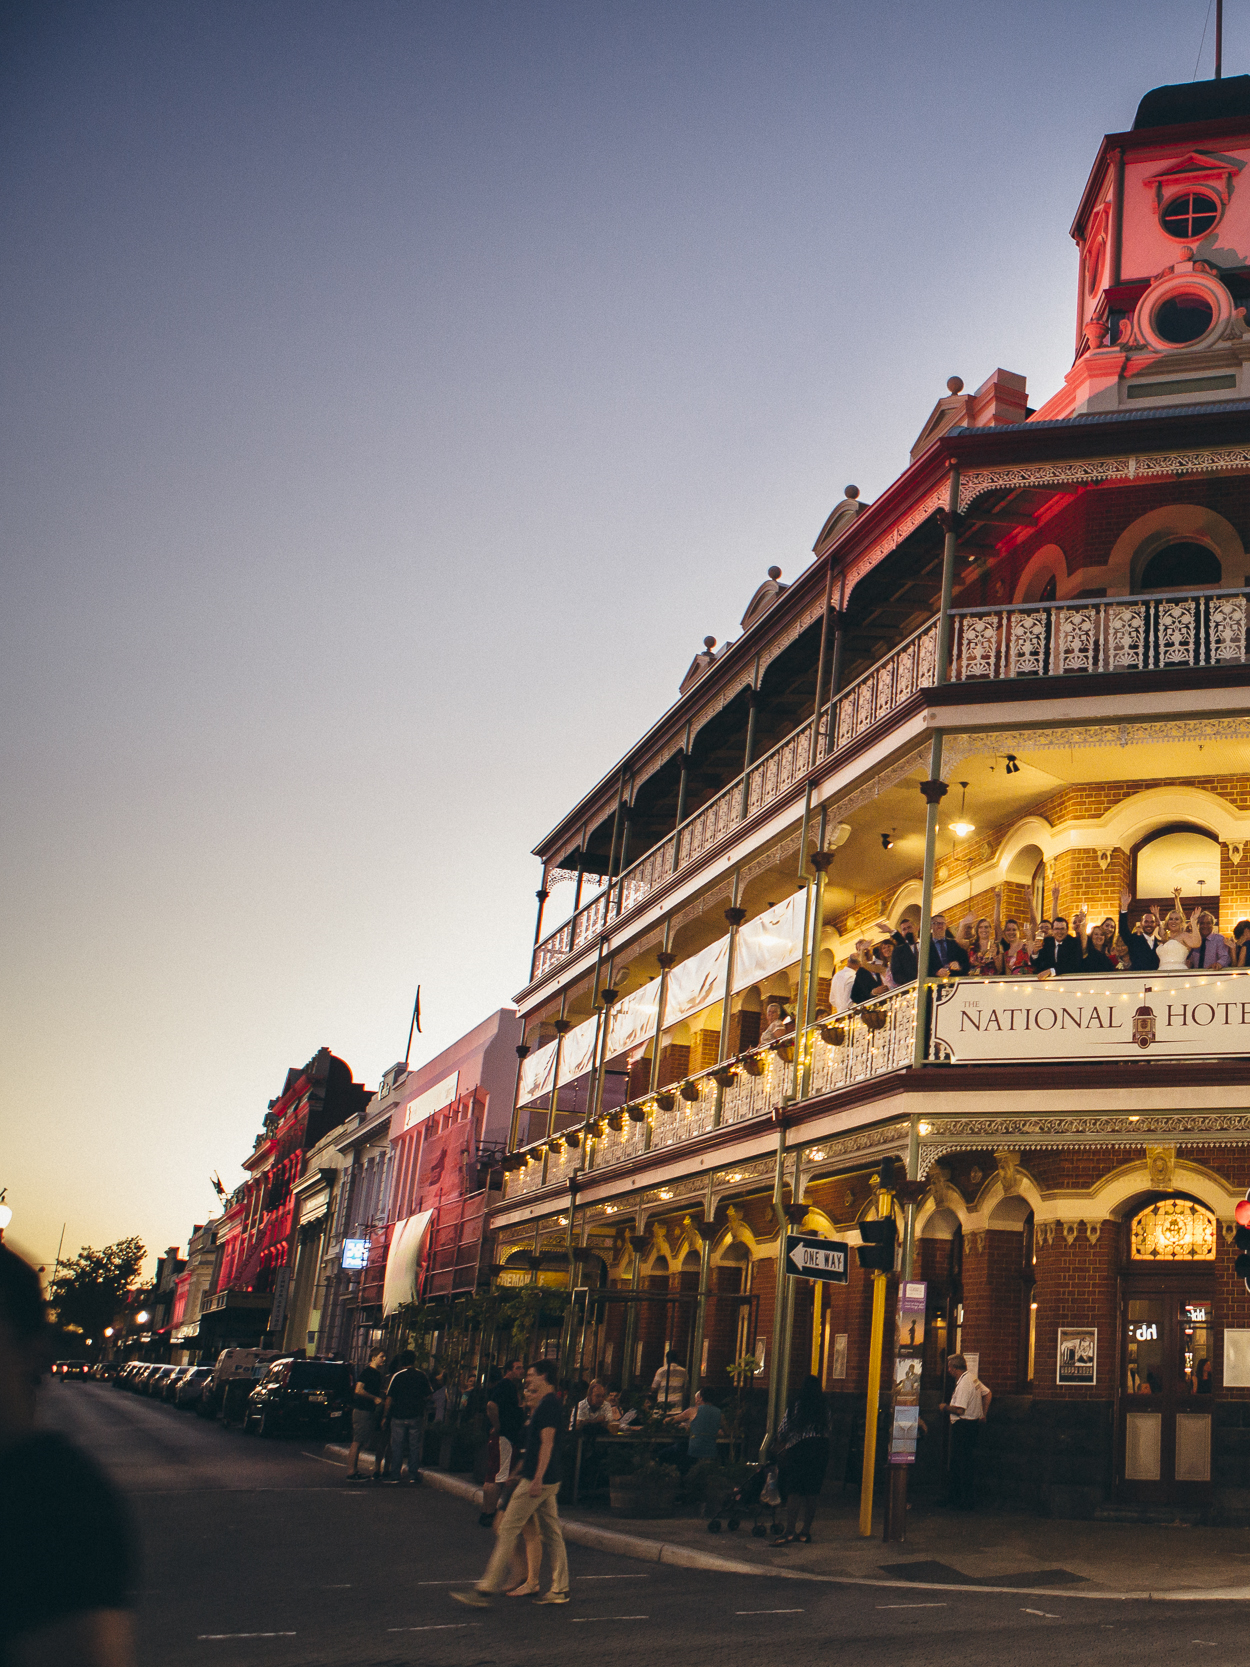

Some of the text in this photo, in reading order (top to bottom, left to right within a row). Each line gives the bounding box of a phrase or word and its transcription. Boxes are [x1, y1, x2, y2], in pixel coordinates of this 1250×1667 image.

[959, 1006, 1124, 1032] NATIONAL
[803, 1249, 842, 1270] ONE WAY
